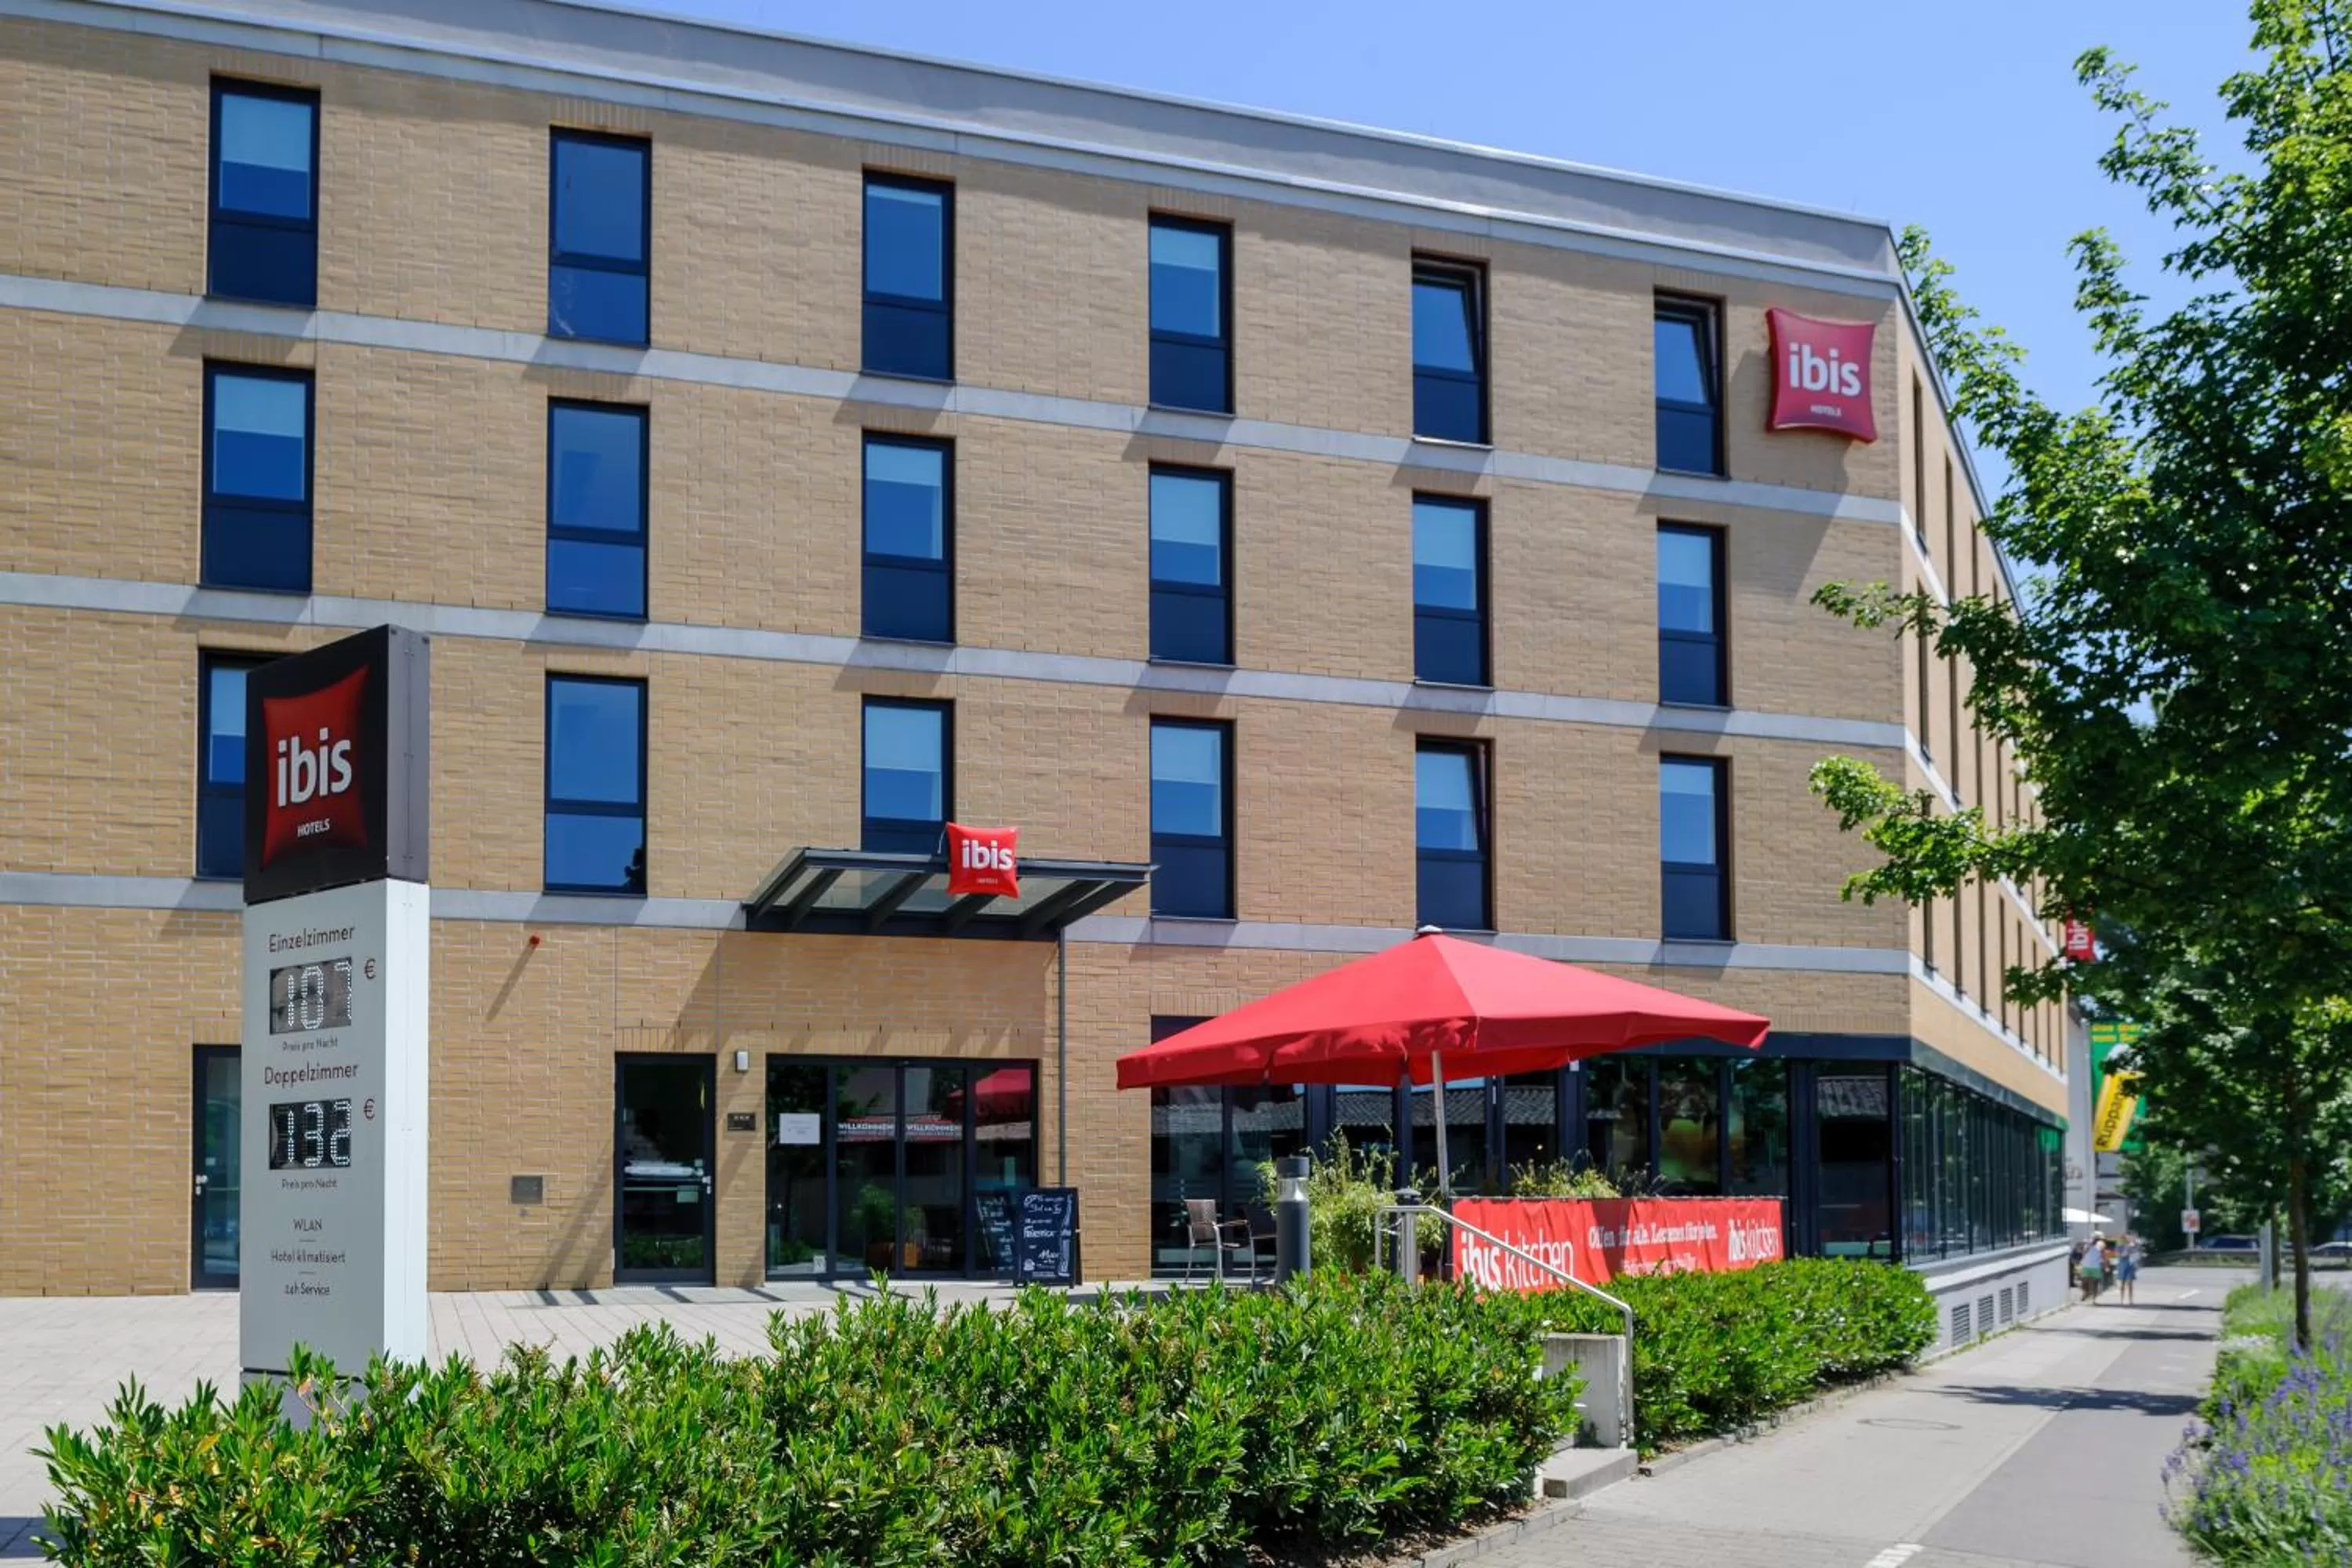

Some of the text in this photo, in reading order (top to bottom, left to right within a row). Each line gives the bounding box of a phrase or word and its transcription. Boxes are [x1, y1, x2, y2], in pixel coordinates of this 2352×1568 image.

[1789, 342, 1861, 397] ibis
[278, 728, 352, 807] ibis
[297, 818, 330, 838] HOTELS
[962, 839, 1013, 870] ibis
[269, 927, 355, 953] Einzelzimmer
[364, 958, 376, 980] €
[316, 1036, 338, 1049] Nacht
[264, 1061, 358, 1088] Doppelzimmer
[287, 1098, 376, 1167] 132 €
[281, 1178, 338, 1192] Preis pro Nacht
[293, 1218, 322, 1232] WLAN
[270, 1247, 295, 1263] Hotel
[300, 1282, 330, 1296] Service
